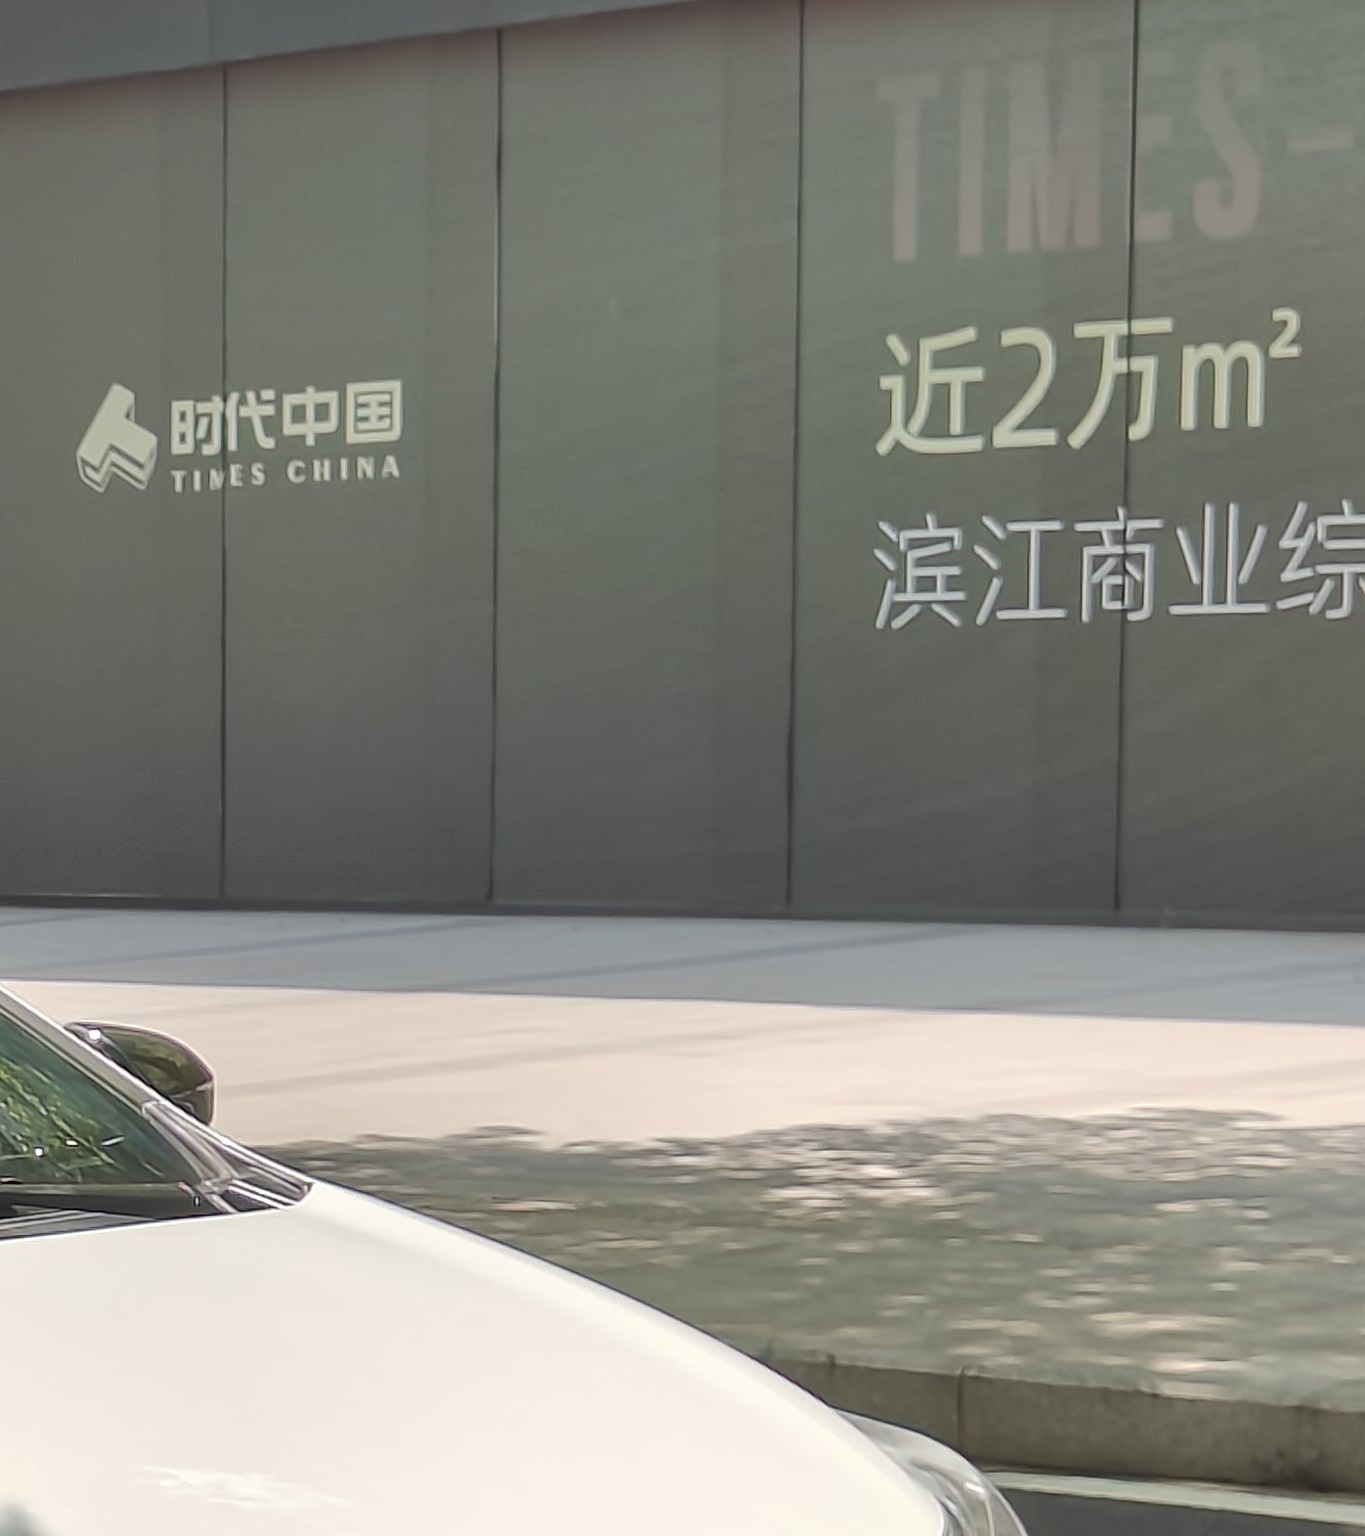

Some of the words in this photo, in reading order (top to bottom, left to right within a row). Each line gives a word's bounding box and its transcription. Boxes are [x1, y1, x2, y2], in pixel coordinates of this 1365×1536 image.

[170, 379, 403, 456] 时代中国
[171, 461, 266, 493] TIMES
[286, 455, 400, 483] CHINA
[873, 499, 1365, 630] 滨江商业综
